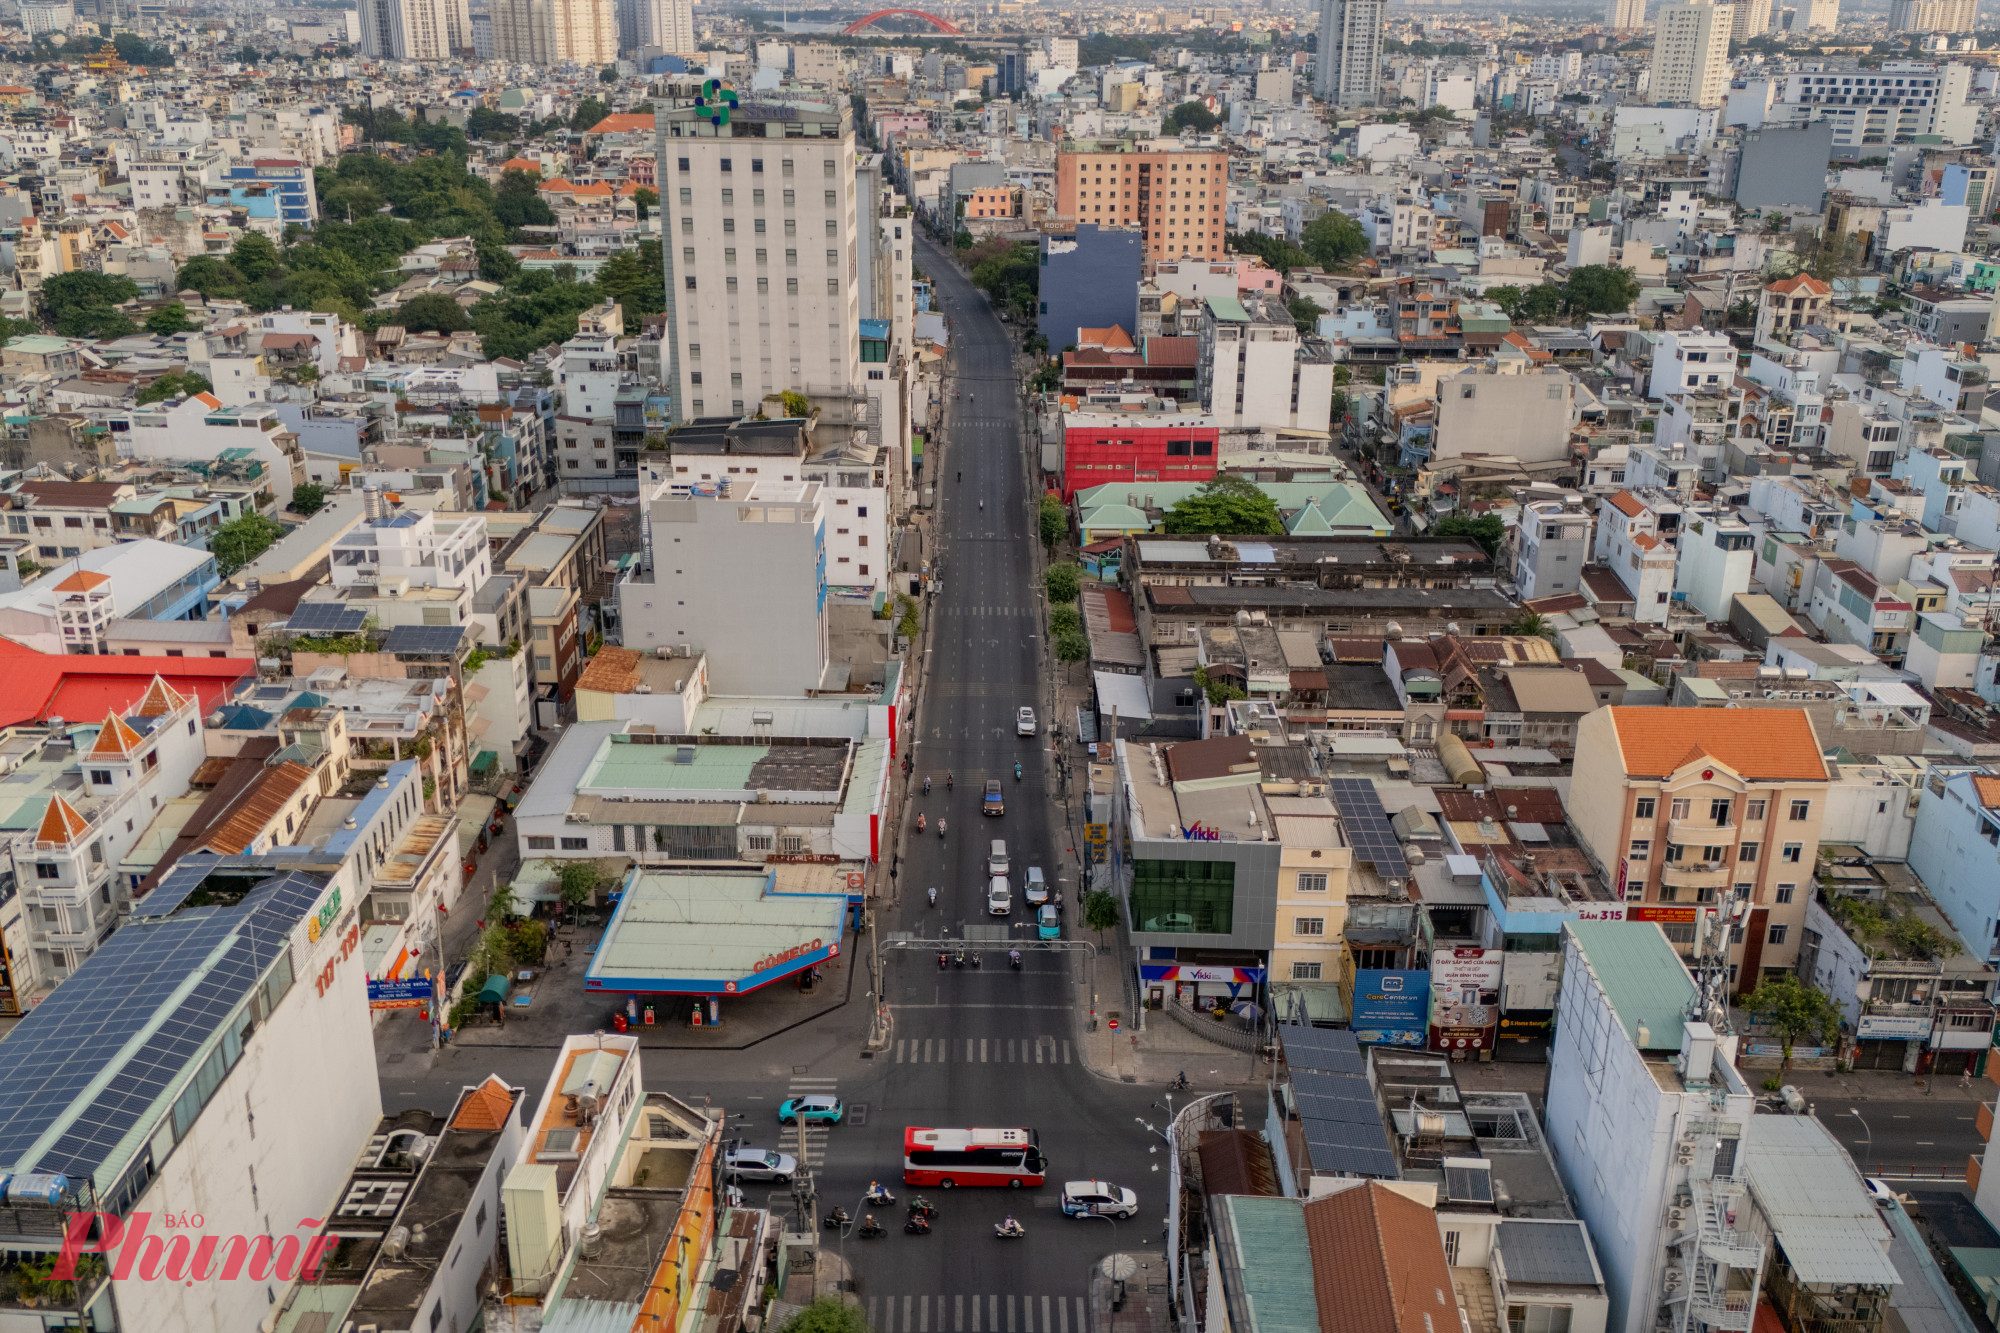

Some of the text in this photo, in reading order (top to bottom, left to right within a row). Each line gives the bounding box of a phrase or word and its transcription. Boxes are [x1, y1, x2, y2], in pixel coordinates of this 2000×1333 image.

[1180, 820, 1219, 840] Vikki
[1600, 911, 1622, 920] 315
[315, 957, 335, 998] 117
[340, 924, 358, 961] 119
[754, 938, 822, 974] COMECO
[1190, 969, 1211, 979] Vikki
